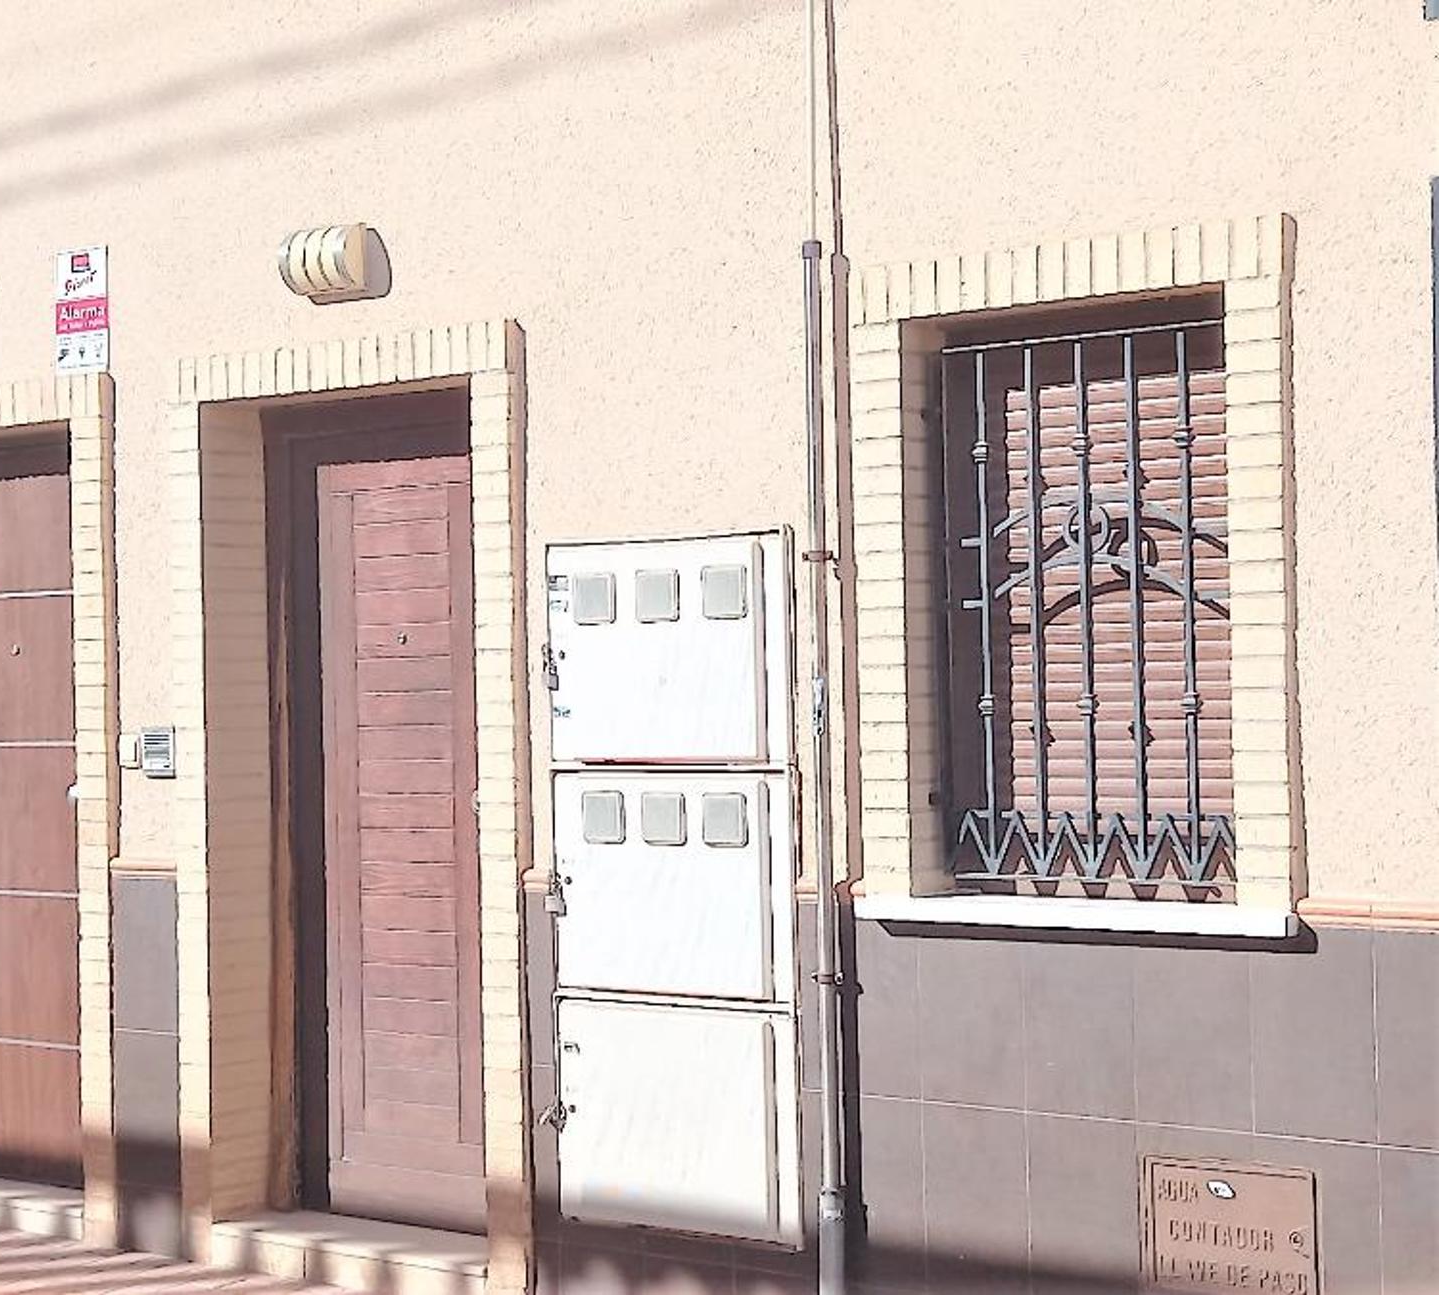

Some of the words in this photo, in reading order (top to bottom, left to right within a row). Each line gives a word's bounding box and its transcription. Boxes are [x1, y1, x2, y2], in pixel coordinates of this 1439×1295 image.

[59, 303, 104, 319] Alarma
[1158, 1179, 1198, 1202] AGUA
[1170, 1219, 1275, 1252] CONTADOR
[1227, 1263, 1252, 1288] DE
[1259, 1269, 1308, 1295] PASO
